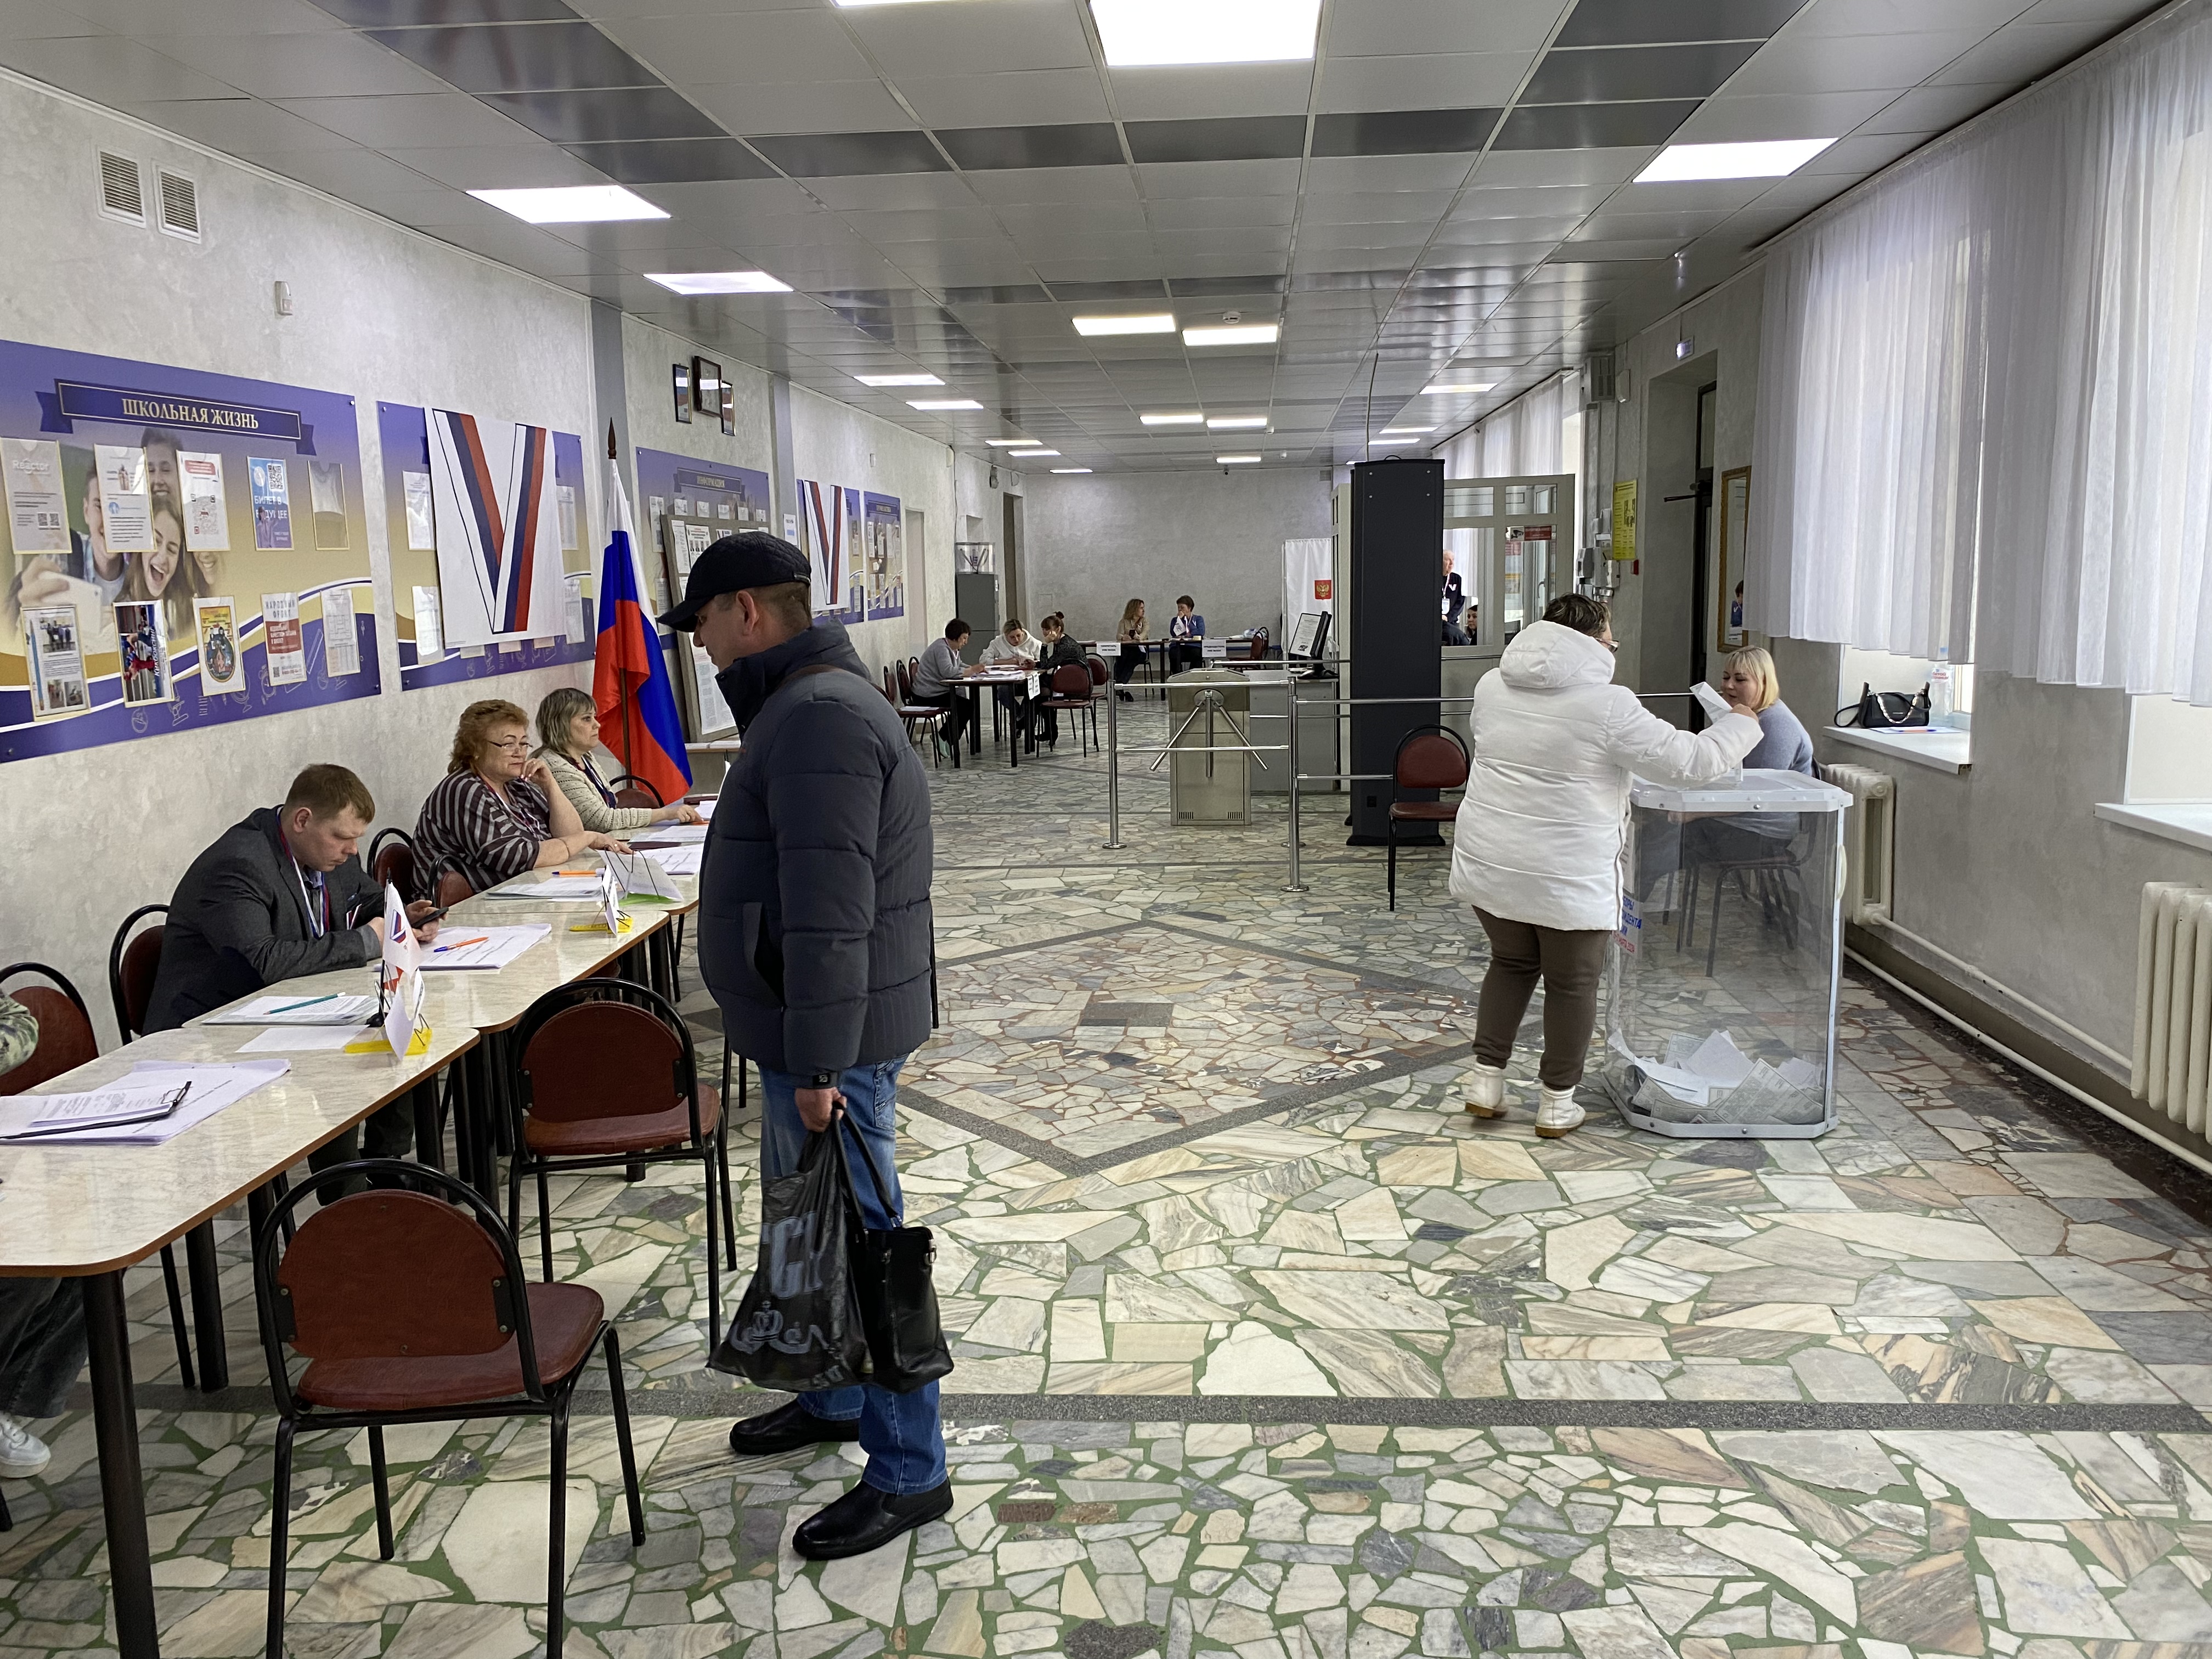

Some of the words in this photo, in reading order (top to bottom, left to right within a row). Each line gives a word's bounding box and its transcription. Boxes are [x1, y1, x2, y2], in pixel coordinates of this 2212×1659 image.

[122, 398, 209, 423] ШКОЛЬНАЯ
[211, 409, 259, 429] ЖИЗНЬ
[254, 495, 276, 505] БИЛЕТ
